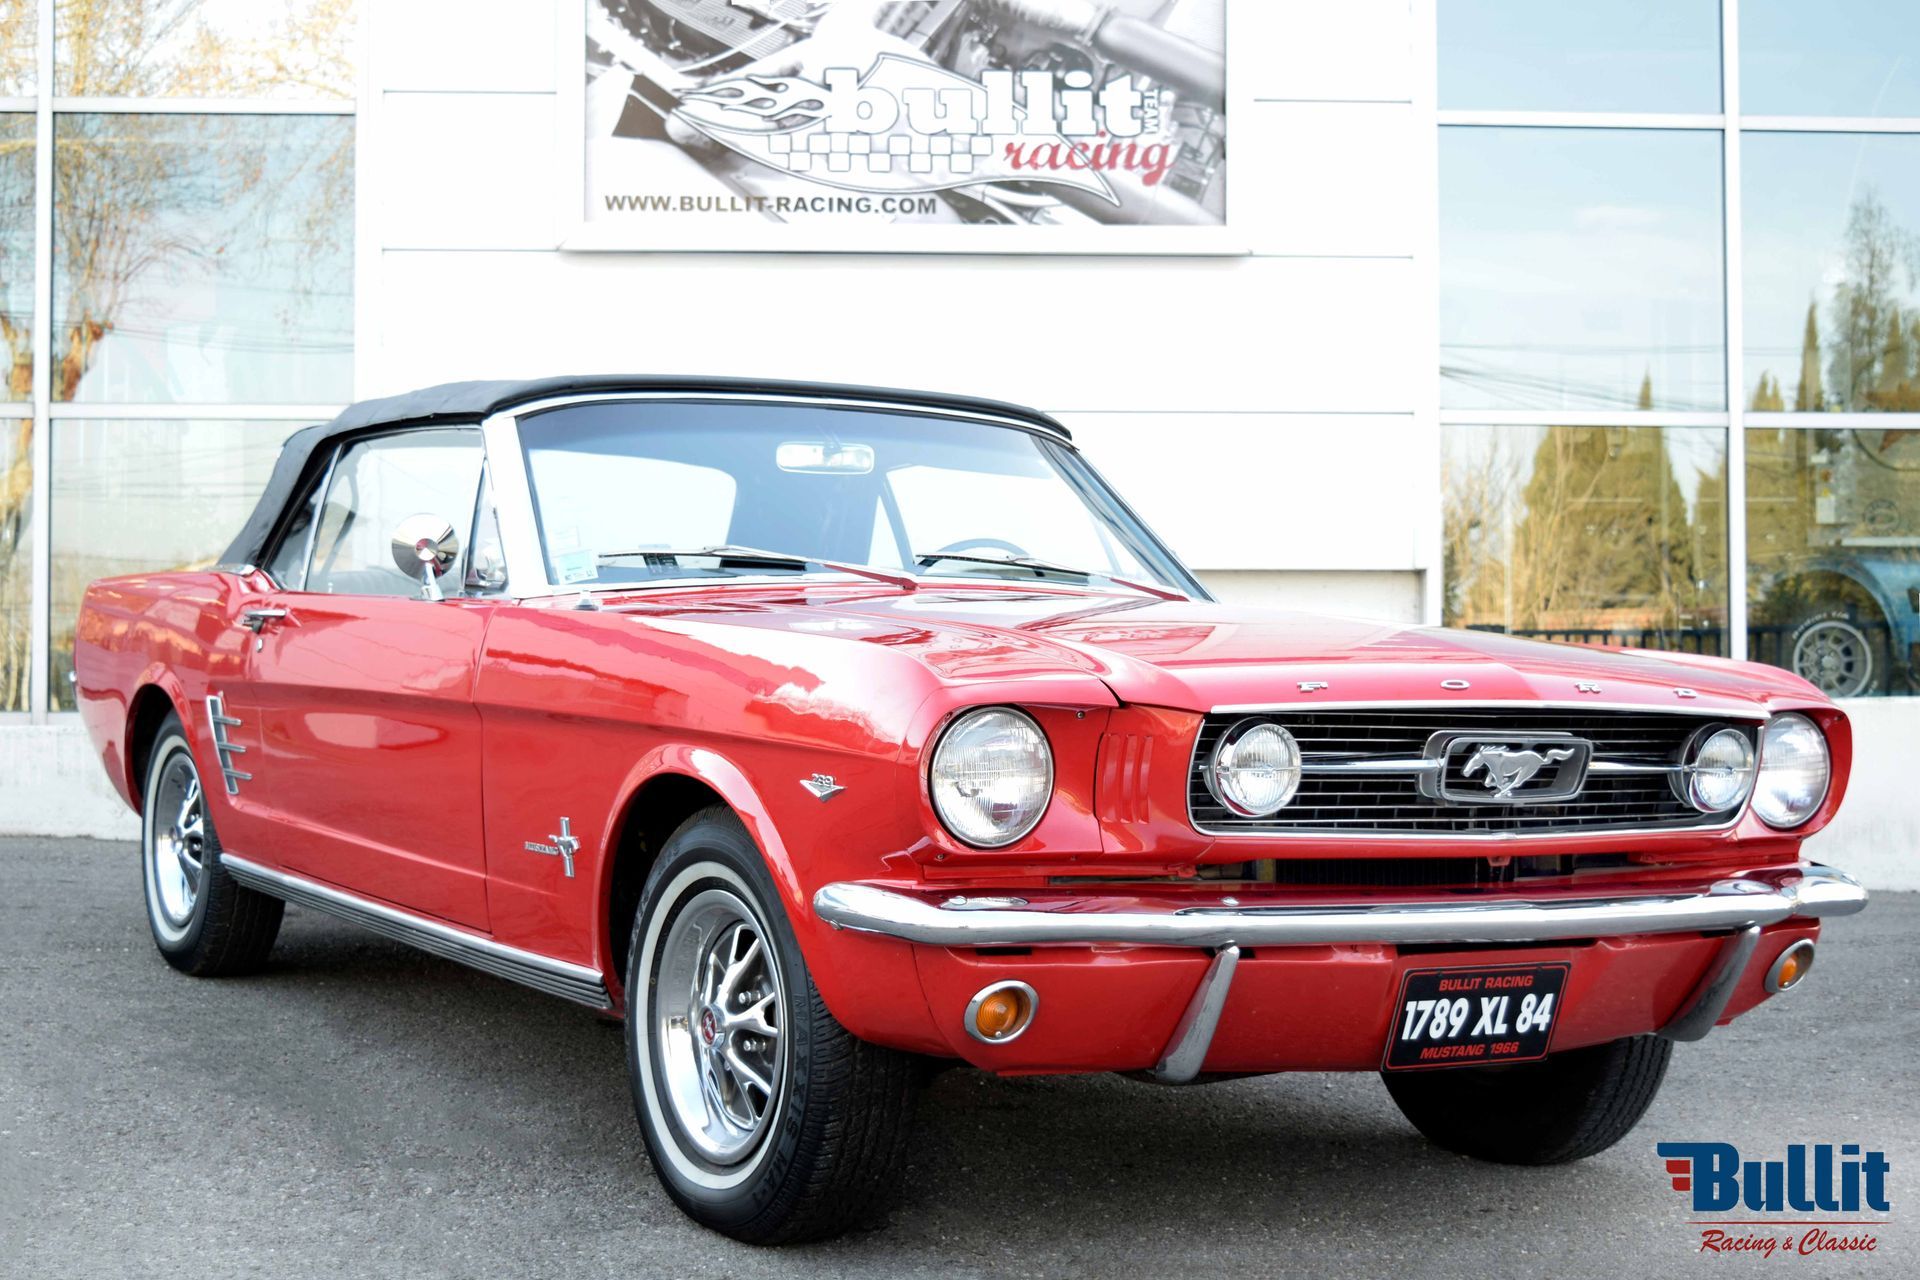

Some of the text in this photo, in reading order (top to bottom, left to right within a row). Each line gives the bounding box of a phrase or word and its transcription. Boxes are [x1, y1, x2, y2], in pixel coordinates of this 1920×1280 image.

[824, 67, 1159, 137] bullit TEAM
[1003, 130, 1177, 187] racing
[604, 195, 937, 214] WWW.BULLIT-RACING.COM
[1439, 975, 1534, 991] BULLIT RACING
[1401, 993, 1554, 1041] 1789 XL 84
[1419, 1041, 1520, 1060] MUSTANG 1966
